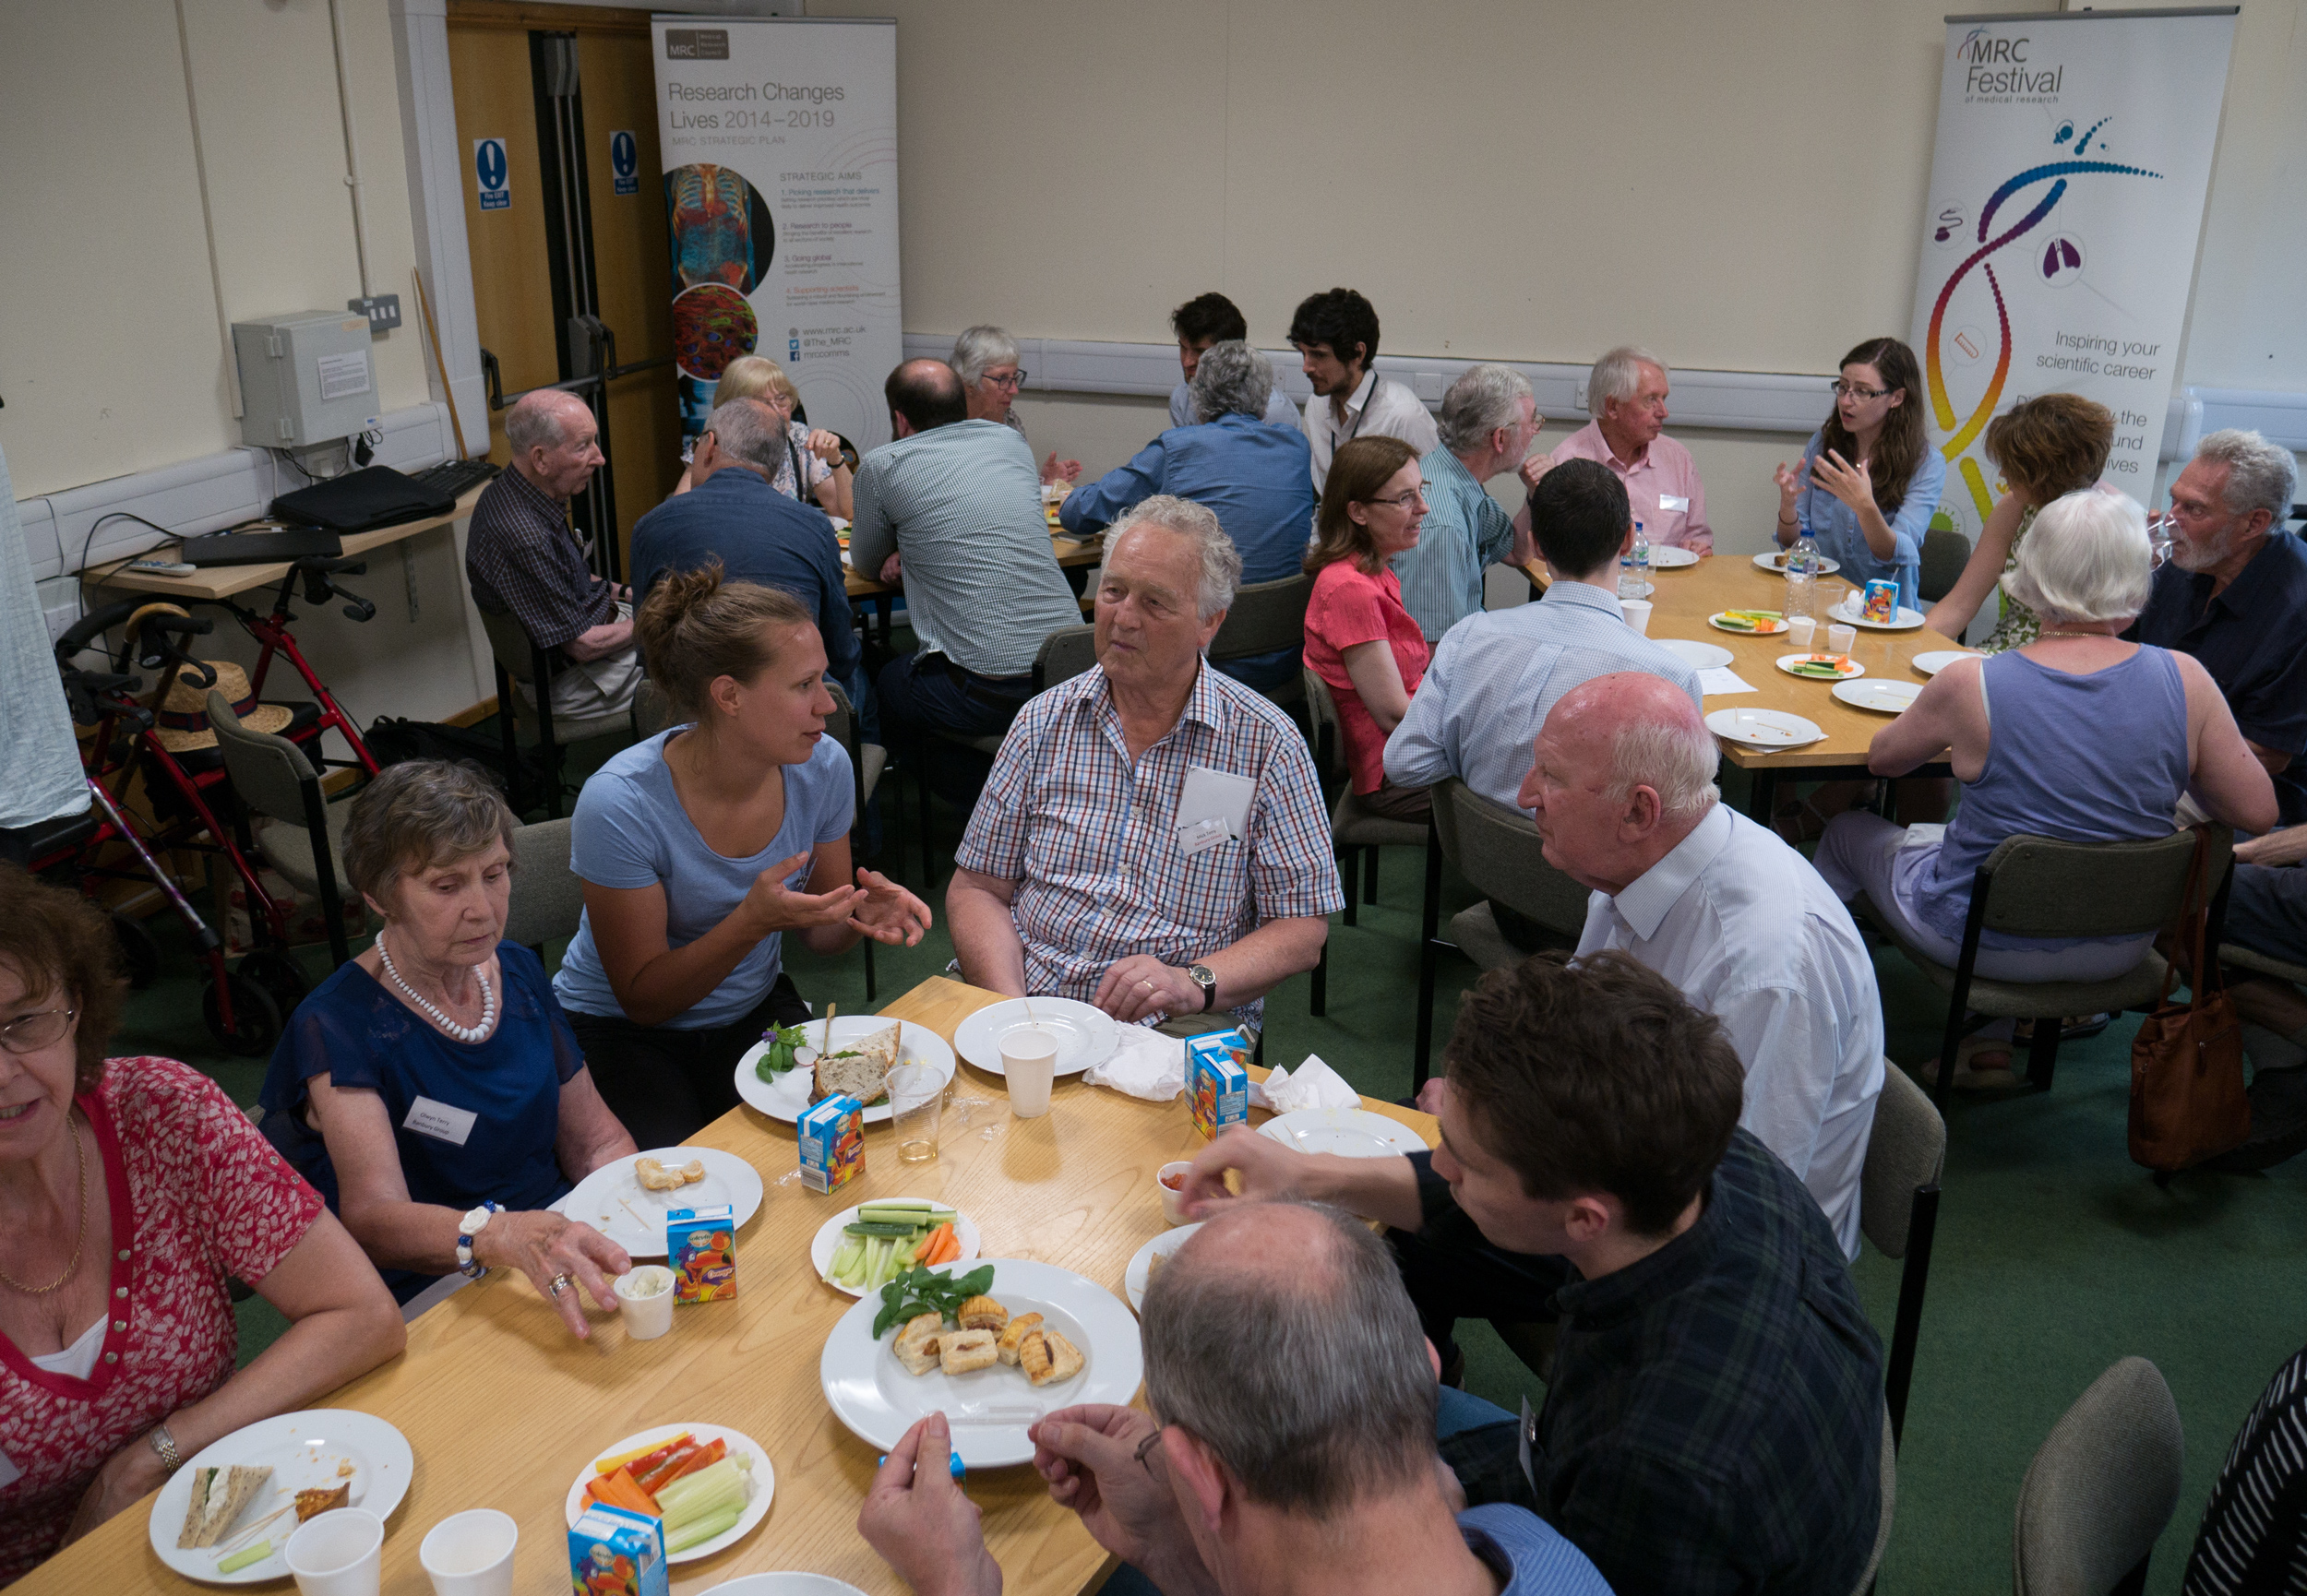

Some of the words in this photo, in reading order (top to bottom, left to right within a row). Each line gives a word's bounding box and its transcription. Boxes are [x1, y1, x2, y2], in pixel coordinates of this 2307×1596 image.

[670, 44, 696, 56] MRC
[1971, 38, 2030, 64] MRC
[1966, 65, 2063, 93] Festival
[668, 82, 757, 101] Research
[763, 81, 844, 105] Changes
[1965, 95, 1975, 103] of
[1977, 95, 2013, 103] medical
[671, 110, 719, 129] Lives
[672, 136, 697, 147] MRC
[699, 136, 756, 146] STRATEGIC
[759, 136, 786, 145] PLAN
[780, 172, 835, 182] STRATEGIC
[838, 171, 862, 181] AIMS
[803, 325, 867, 336] www.mrc.ac.uk
[803, 337, 852, 347] @The_MRC
[2055, 330, 2118, 356] Inspiring
[2122, 340, 2160, 357] your
[804, 350, 850, 358] mrccomms
[2036, 353, 2099, 375] scientific
[2103, 363, 2157, 380] career
[2121, 410, 2147, 427] the
[412, 1119, 433, 1130] Banbury
[434, 1126, 449, 1135] Group
[436, 1117, 449, 1126] Terry
[707, 1268, 733, 1279] Orange
